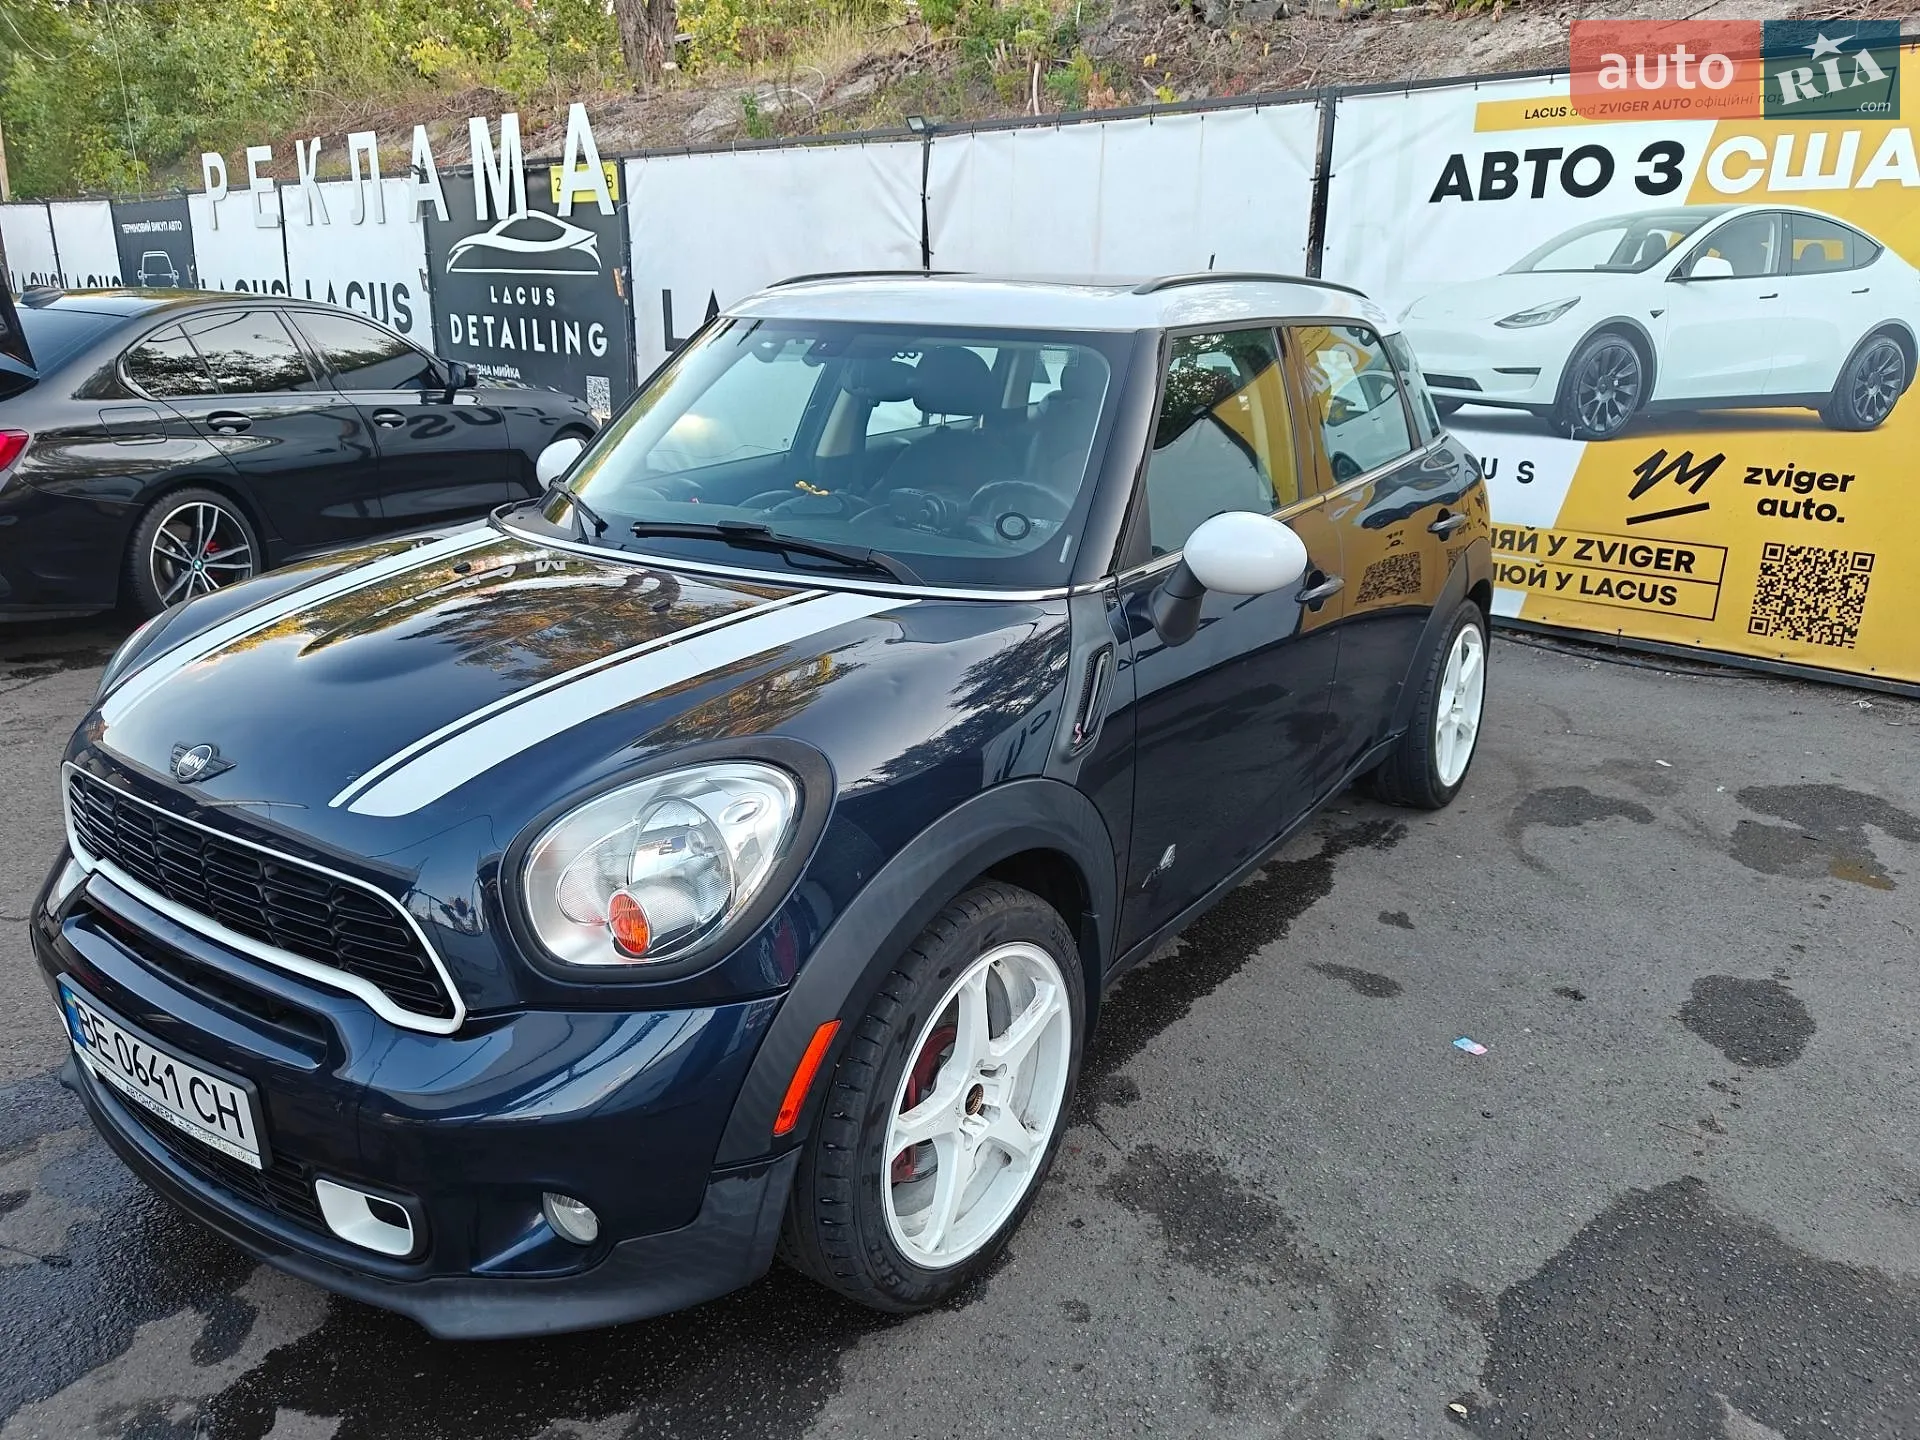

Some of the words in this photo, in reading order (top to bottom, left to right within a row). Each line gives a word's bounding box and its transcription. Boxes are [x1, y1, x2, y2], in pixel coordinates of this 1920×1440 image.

[1524, 106, 1567, 119] LACUS
[1569, 105, 1596, 117] and
[1599, 100, 1649, 115] ZVIGER
[1652, 98, 1691, 111] AUTO
[1695, 92, 1753, 109] офіційні
[202, 102, 615, 232] РЕКЛАМА
[1428, 143, 1615, 203] АВТО
[1706, 127, 1920, 194] США
[489, 285, 555, 307] LACUS
[450, 313, 608, 357] DETAILING
[492, 363, 521, 380] МИЙКА
[1744, 462, 1855, 494] zviger
[1756, 498, 1846, 524] auto.
[1547, 534, 1567, 557] У
[1573, 538, 1696, 574] ZVIGER
[1555, 571, 1573, 591] У
[1579, 575, 1678, 607] LACUS
[180, 752, 206, 770] MINI
[74, 1001, 115, 1065] BE
[114, 1031, 184, 1110] 0641
[189, 1076, 245, 1139] CH
